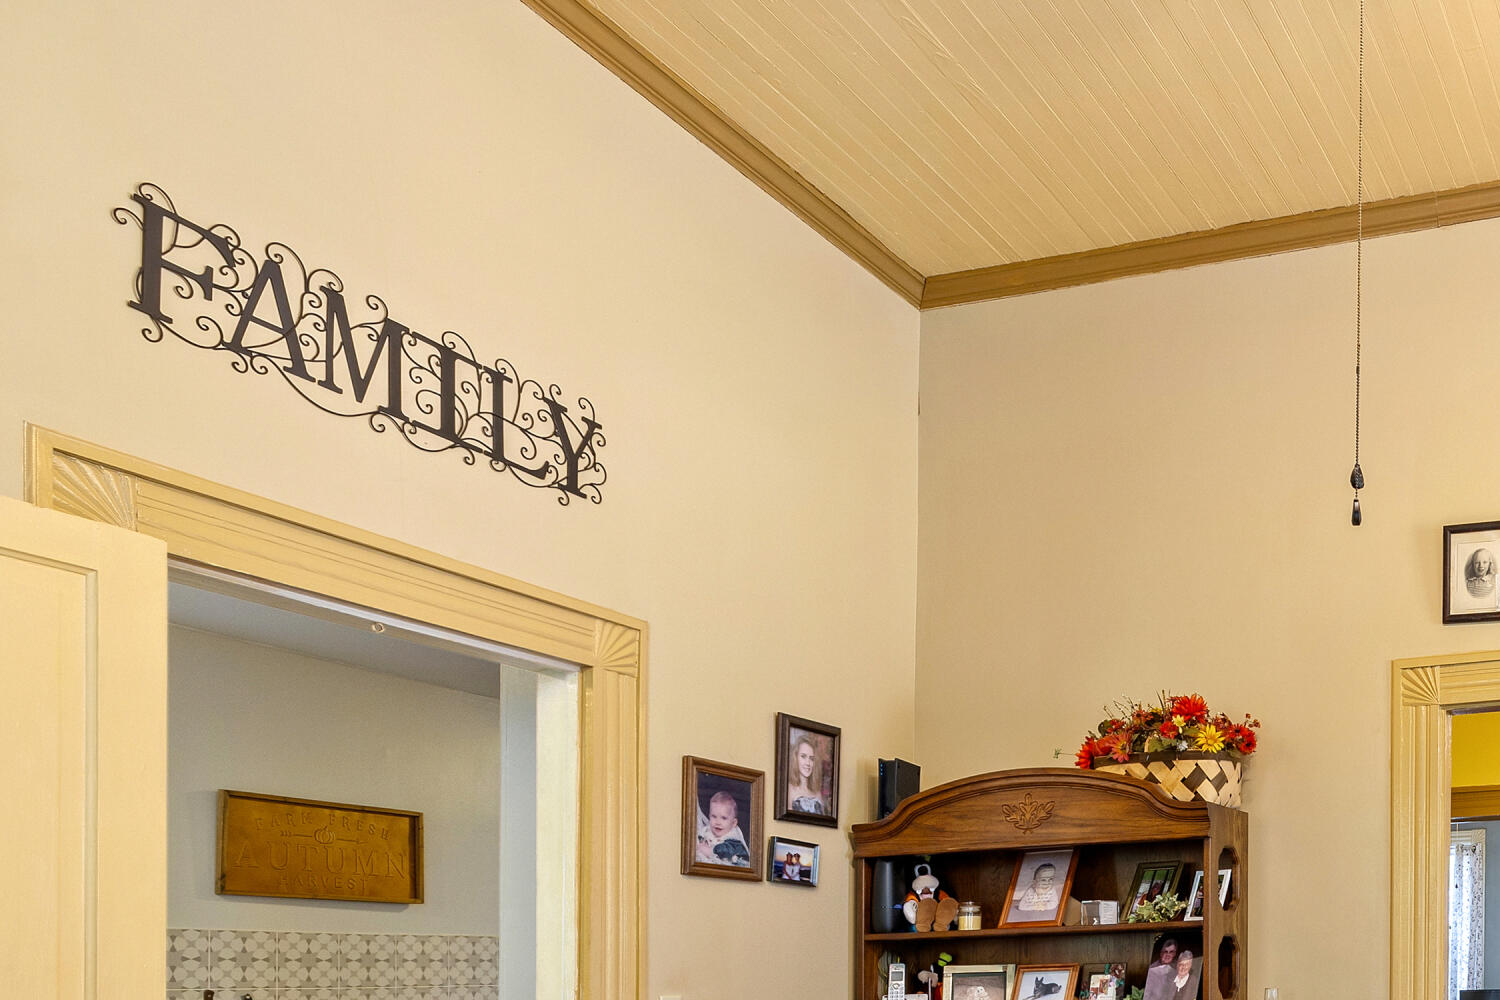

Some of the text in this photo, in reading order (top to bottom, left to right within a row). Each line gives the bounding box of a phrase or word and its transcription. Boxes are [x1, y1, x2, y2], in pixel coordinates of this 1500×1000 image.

[129, 192, 603, 500] FAMILY
[255, 812, 391, 841] FARM FRESH
[231, 840, 408, 880] AUTUMN
[279, 875, 369, 896] HARVEST
